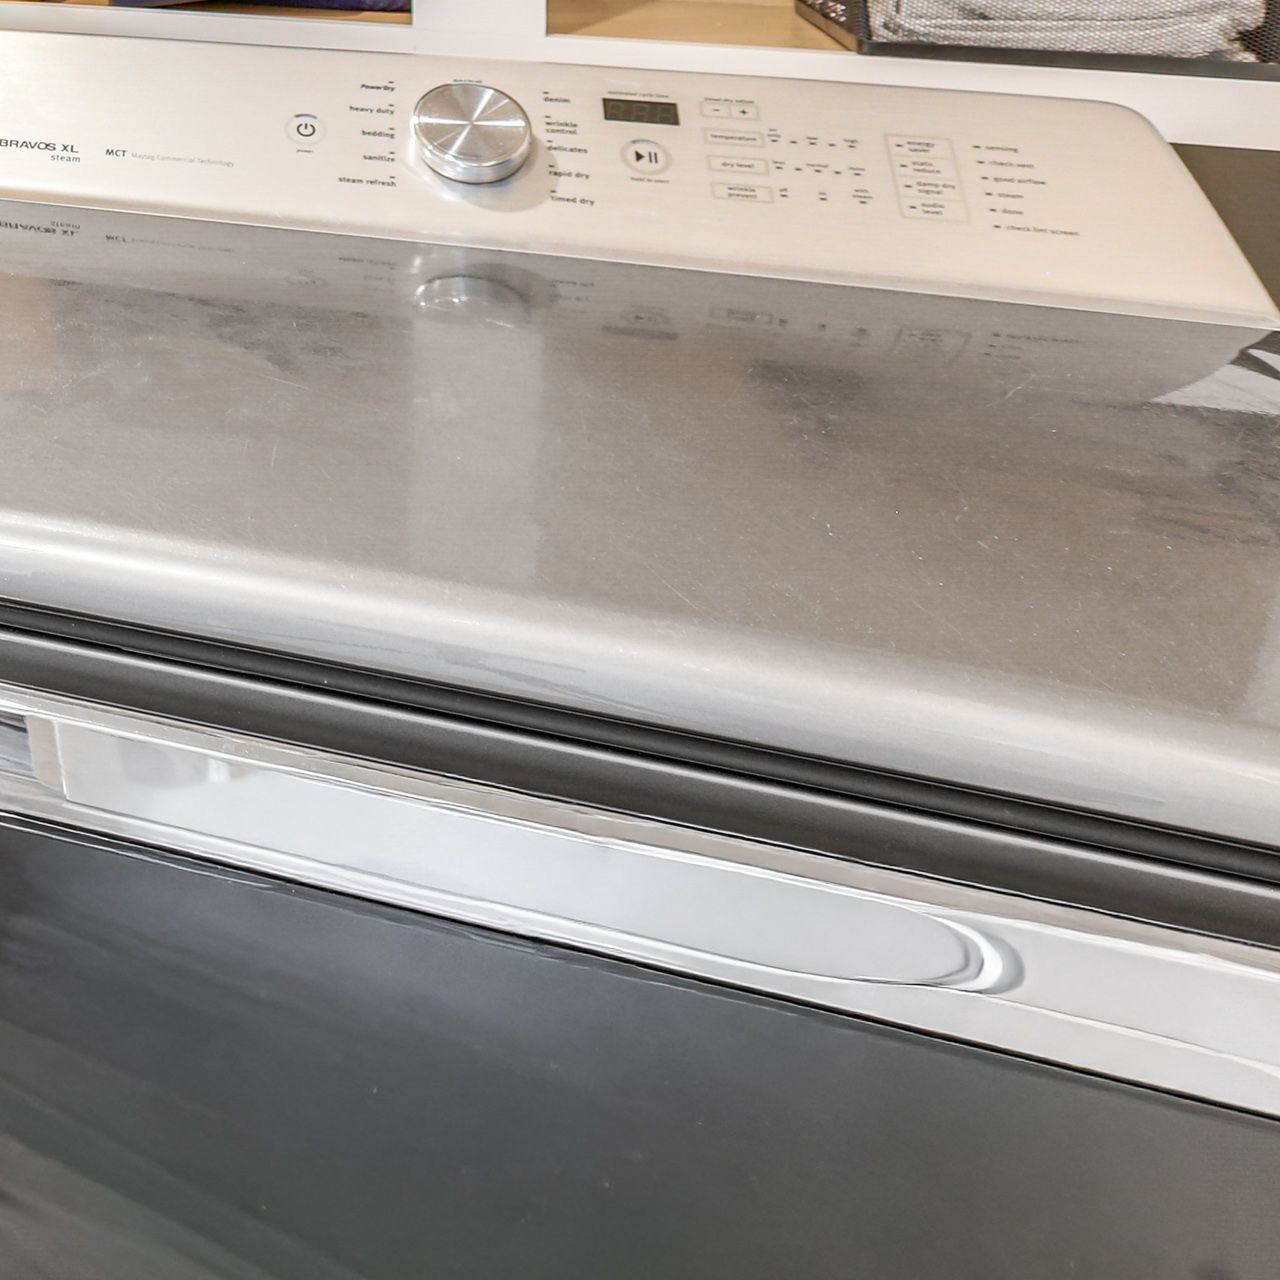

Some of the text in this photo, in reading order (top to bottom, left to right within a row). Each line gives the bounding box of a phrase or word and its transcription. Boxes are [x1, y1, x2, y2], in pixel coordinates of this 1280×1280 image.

[349, 105, 395, 115] heavy duty
[361, 129, 395, 139] bedding
[0, 138, 79, 154] BRAVOS XL
[546, 145, 588, 154] delicates
[51, 153, 81, 163] steam
[106, 148, 127, 158] MCT
[549, 170, 590, 180] rapid dry
[338, 176, 397, 187] steam refresh
[550, 195, 595, 206] timed dry
